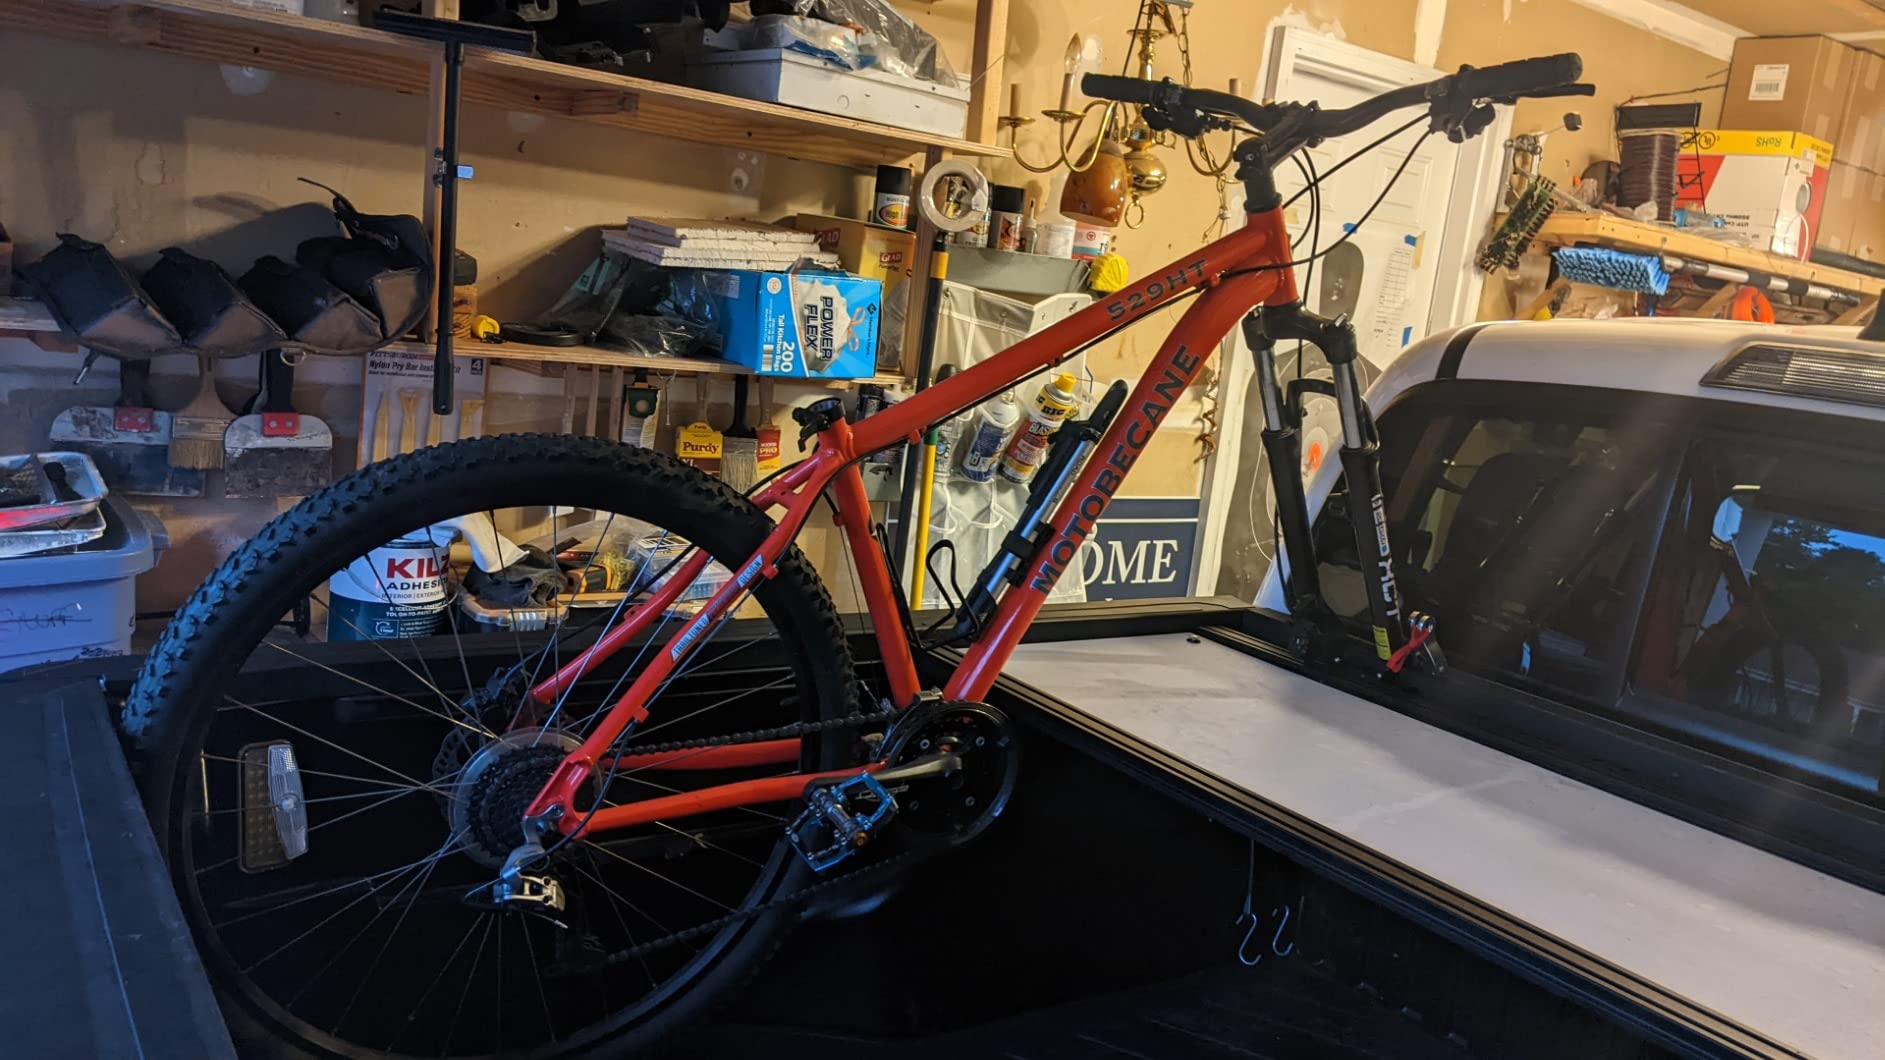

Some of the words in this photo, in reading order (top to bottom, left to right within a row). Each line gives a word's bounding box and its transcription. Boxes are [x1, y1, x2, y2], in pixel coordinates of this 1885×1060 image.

[1755, 136, 1782, 148] RoHS
[881, 252, 902, 262] GLAD
[1106, 258, 1207, 321] 529HT
[804, 304, 819, 352] FLEX
[820, 296, 834, 361] POWER
[780, 341, 795, 373] 200
[682, 441, 720, 454] Purdy
[1030, 345, 1201, 595] MOTOBECANE
[387, 555, 449, 578] KILZ
[1084, 539, 1179, 586] OME
